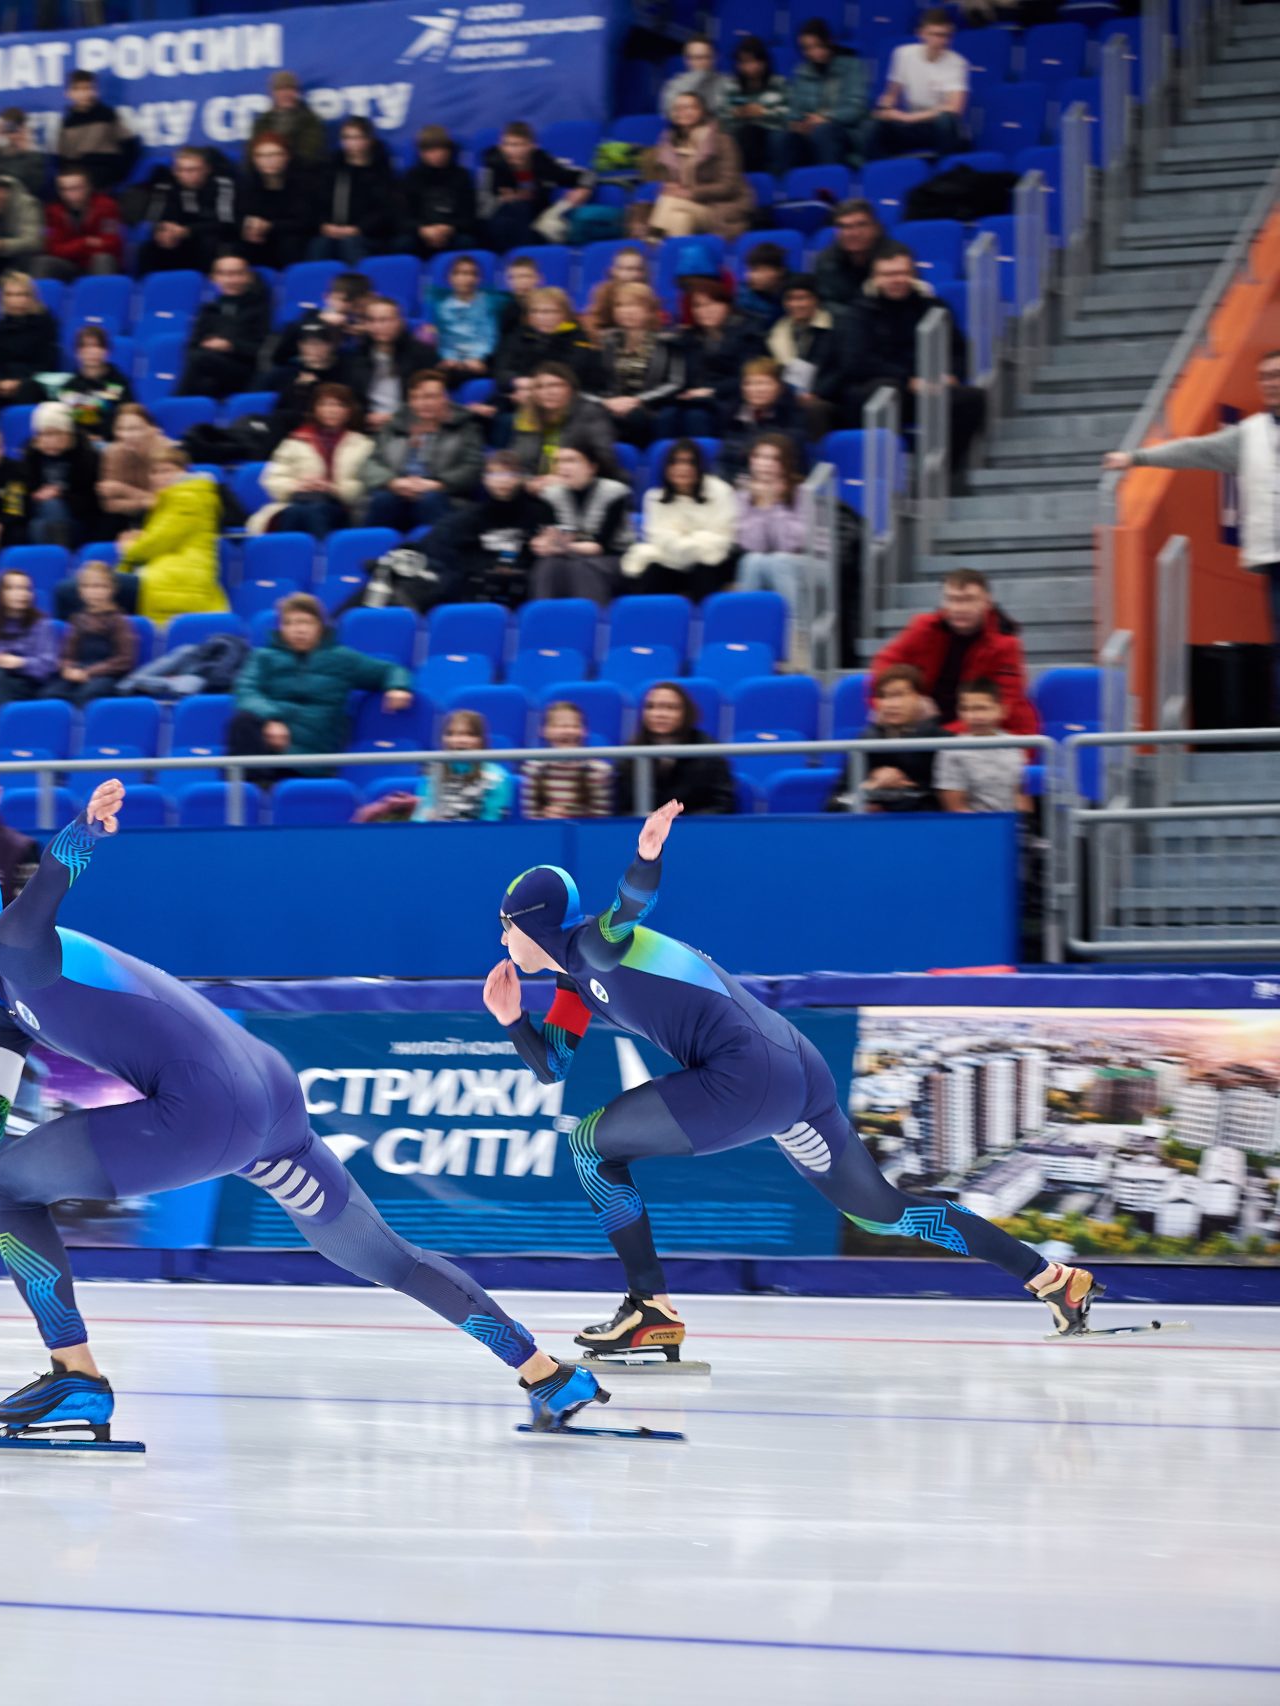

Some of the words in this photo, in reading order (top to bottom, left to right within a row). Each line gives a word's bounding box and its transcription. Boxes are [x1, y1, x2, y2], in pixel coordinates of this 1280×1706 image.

[75, 23, 284, 80] РОССИИ
[297, 1067, 565, 1117] СТРИЖИ
[372, 1127, 559, 1177] СИТИ
